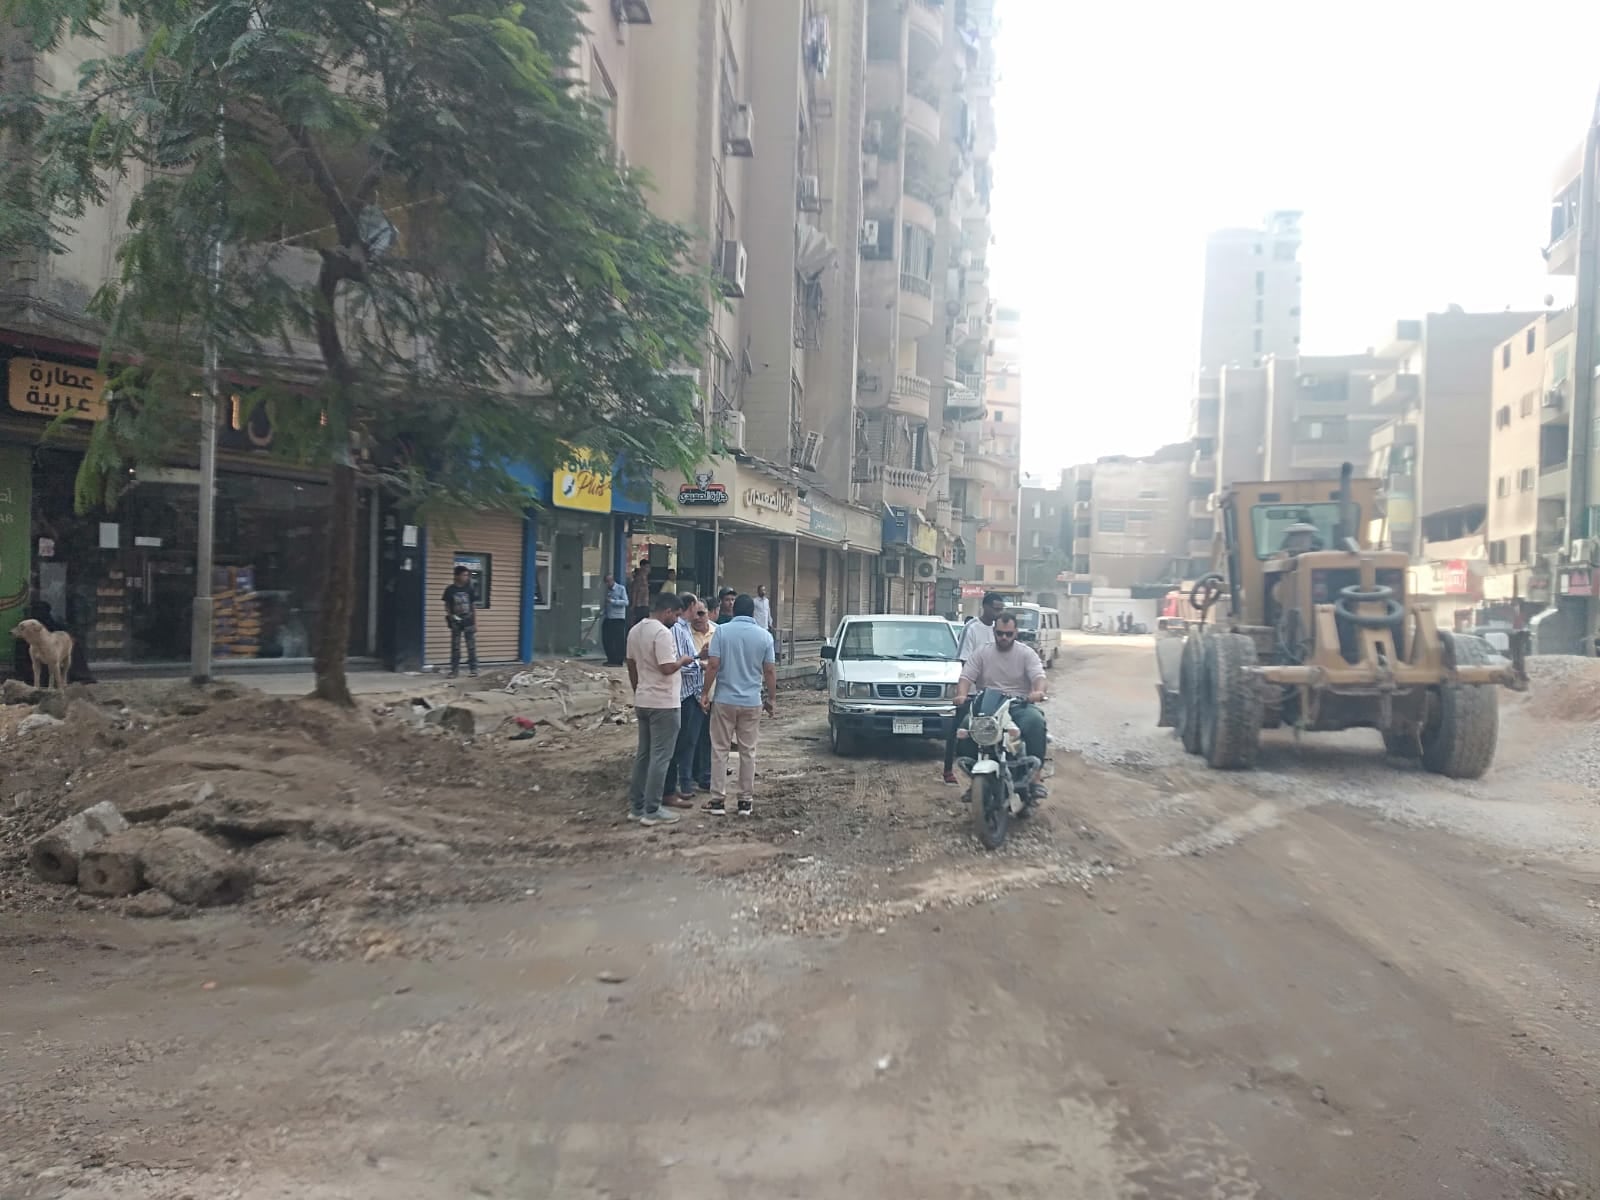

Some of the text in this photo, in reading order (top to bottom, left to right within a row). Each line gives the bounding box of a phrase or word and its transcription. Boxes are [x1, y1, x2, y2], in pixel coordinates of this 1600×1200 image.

[29, 363, 94, 391] عطارة
[26, 385, 91, 413] عربية
[577, 470, 612, 497] Plus
